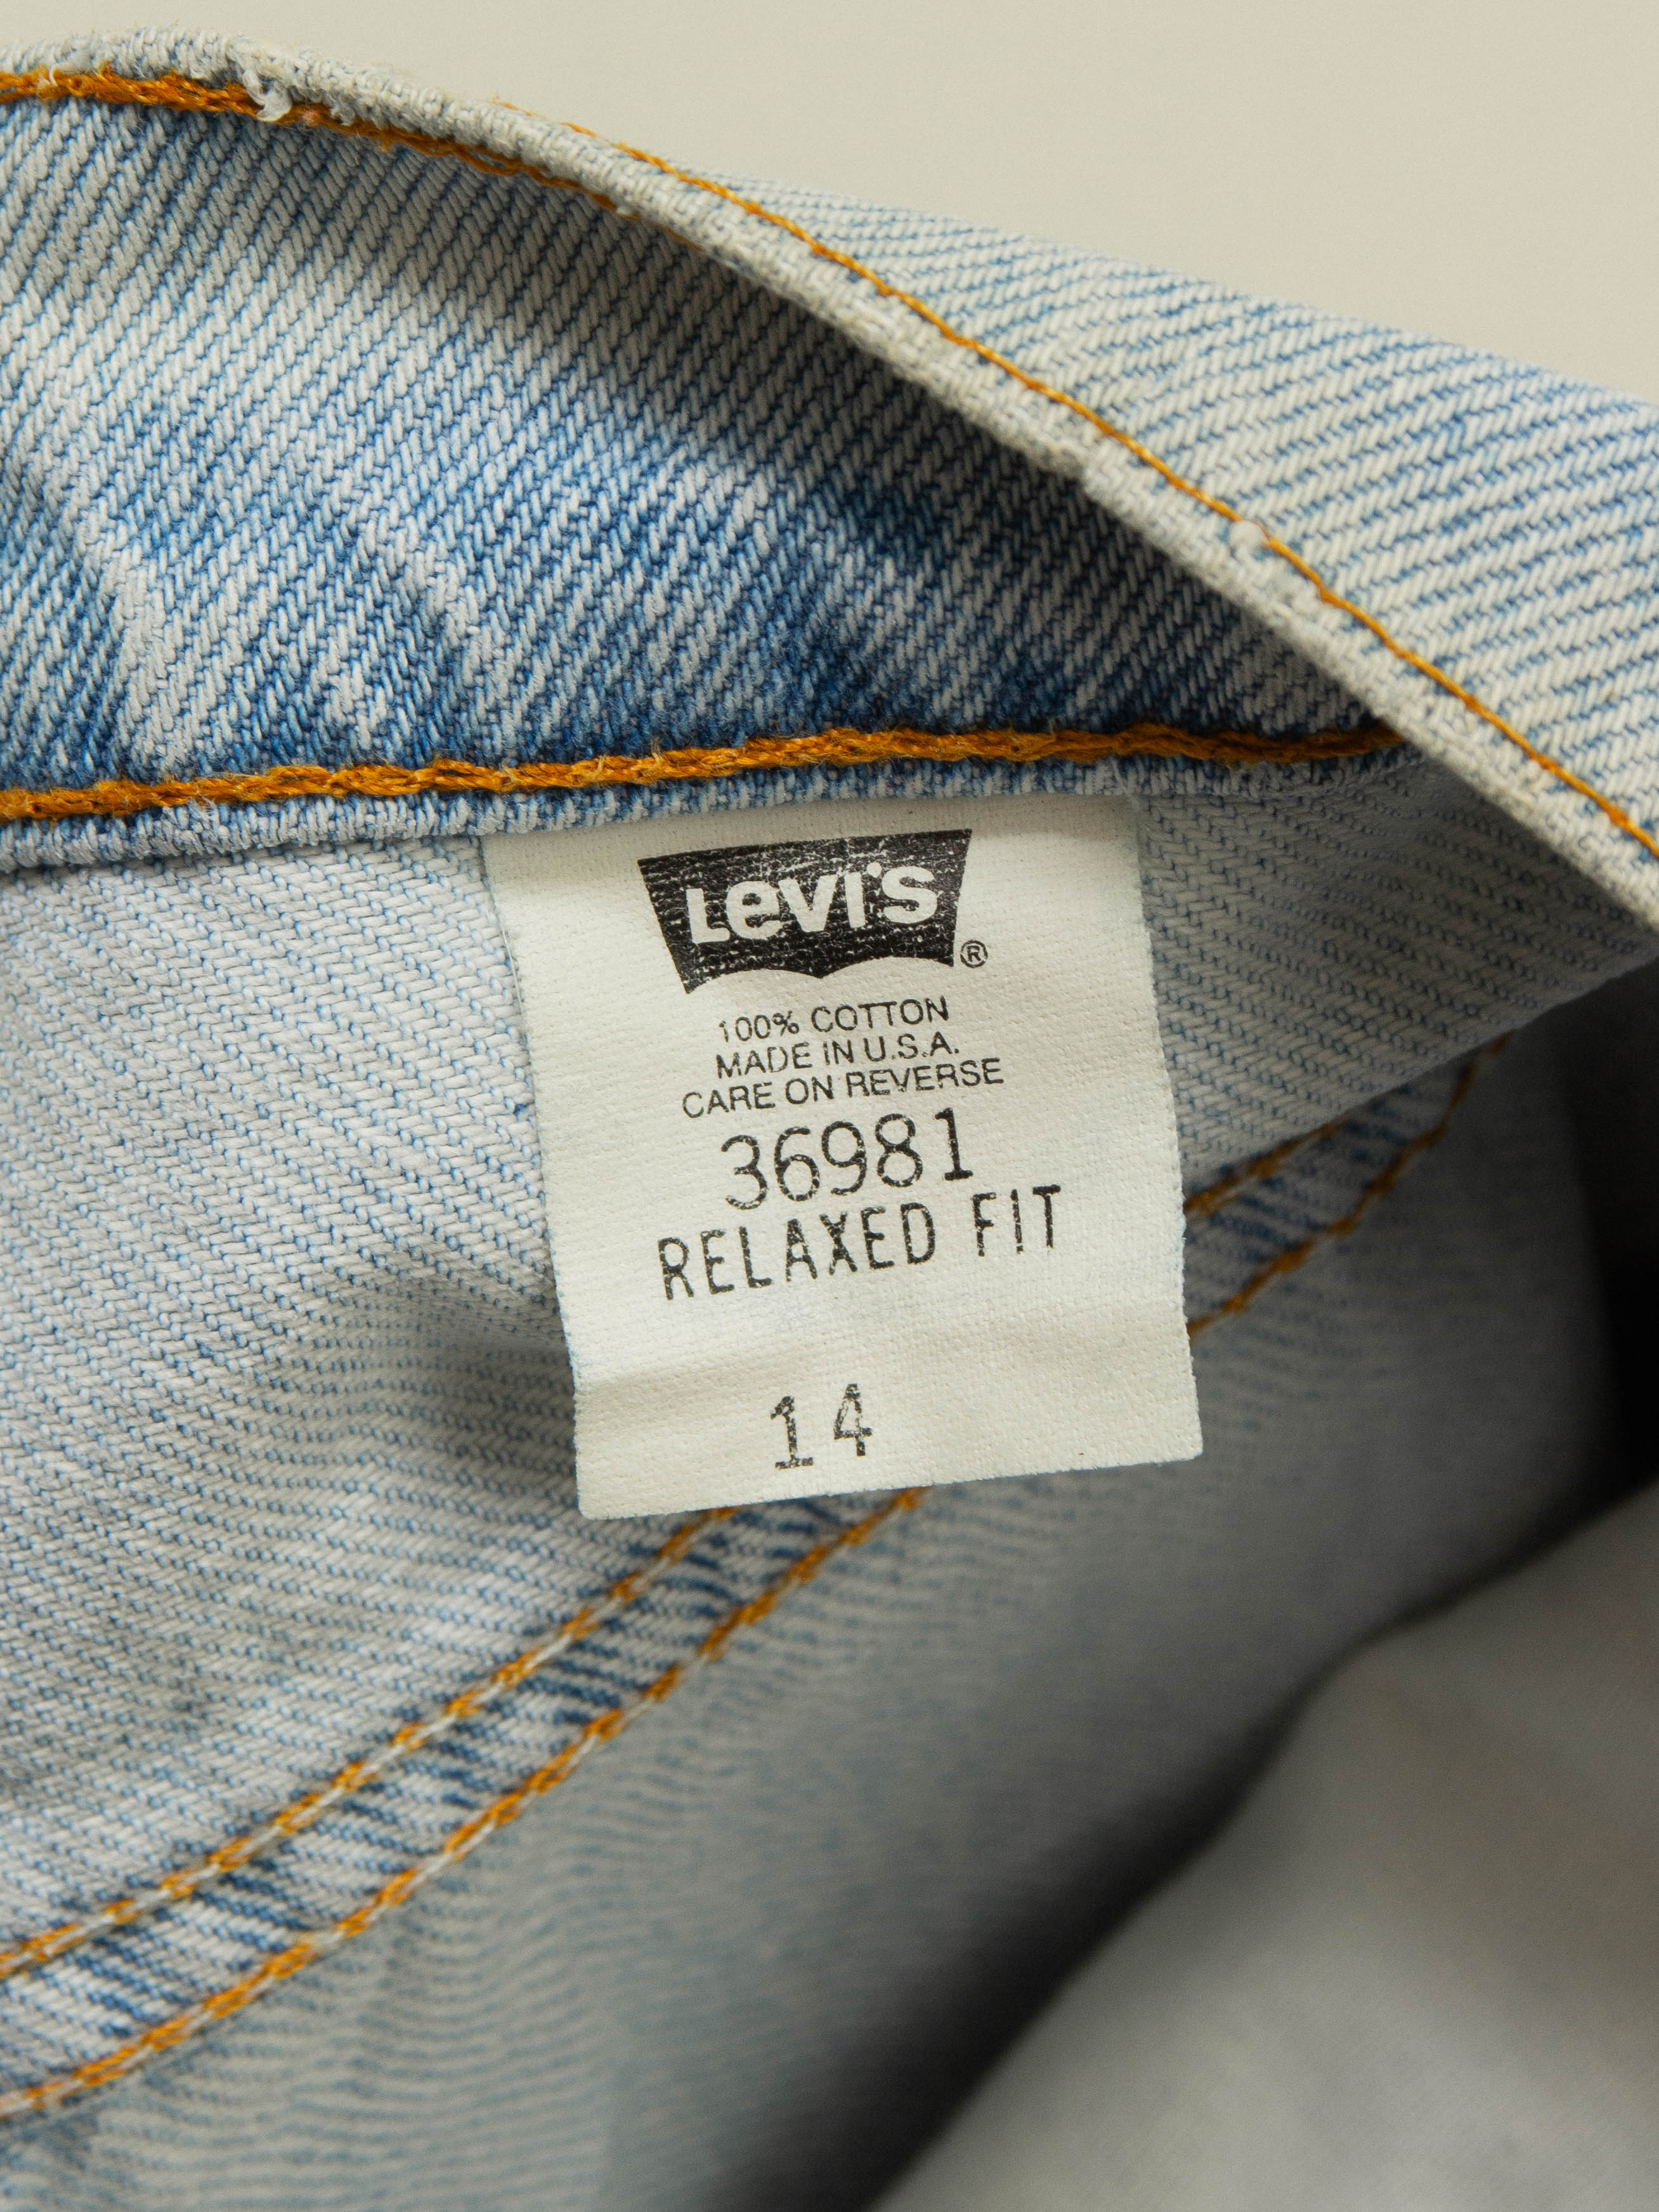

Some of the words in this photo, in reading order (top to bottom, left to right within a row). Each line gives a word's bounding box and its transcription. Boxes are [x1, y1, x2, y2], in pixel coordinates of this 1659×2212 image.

[716, 1042, 813, 1079] MADE
[824, 1039, 854, 1066] IN
[862, 1031, 959, 1063] U.S.A.
[719, 1011, 800, 1043] 100%
[810, 996, 949, 1033] COTTON
[682, 1081, 776, 1119] CARE
[784, 1075, 835, 1105] ON
[845, 1057, 1005, 1098] REVERSE
[720, 1107, 974, 1210] 36981
[658, 1202, 936, 1301] RELAXED
[970, 1184, 1062, 1258] FIT
[769, 1383, 873, 1470] 14
